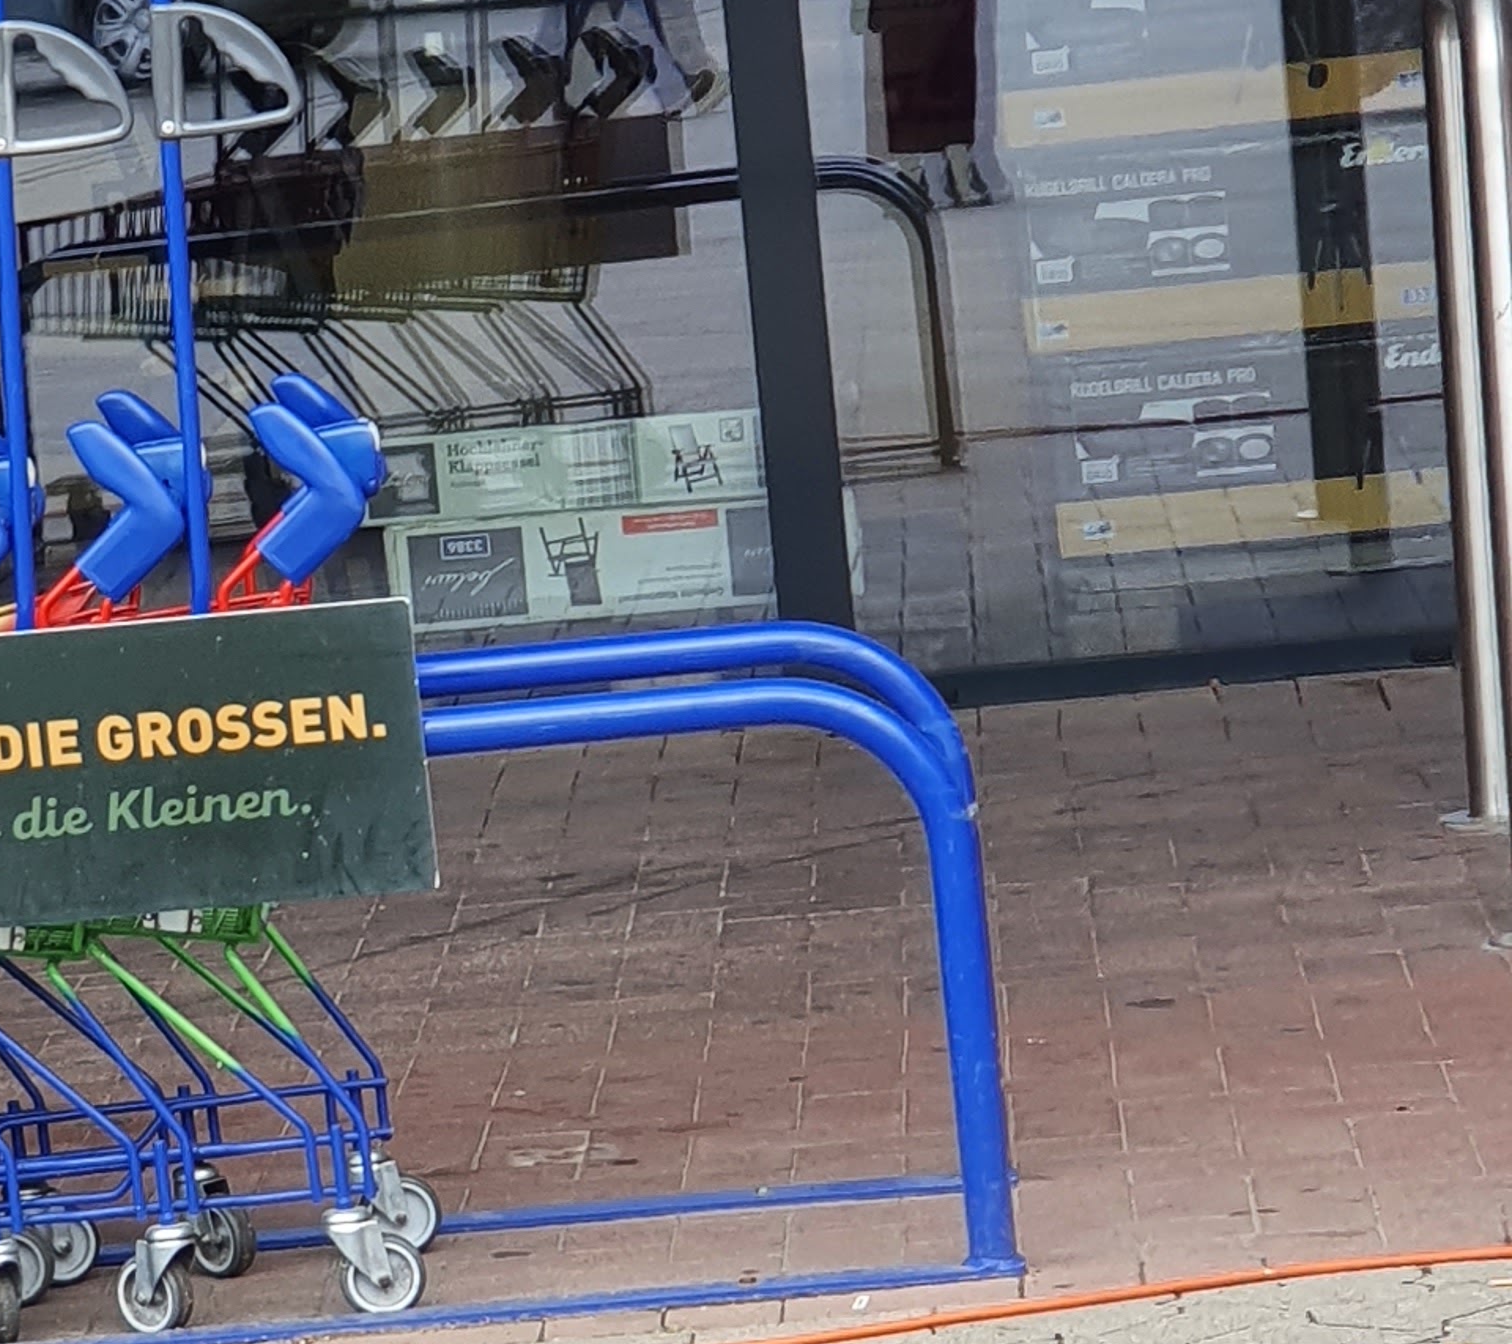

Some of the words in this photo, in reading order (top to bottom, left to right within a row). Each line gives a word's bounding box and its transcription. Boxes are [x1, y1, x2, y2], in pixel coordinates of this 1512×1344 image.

[1385, 342, 1441, 369] End
[96, 693, 388, 762] GROSSEN.
[12, 794, 94, 841] die
[108, 783, 313, 831] Kleinen.
